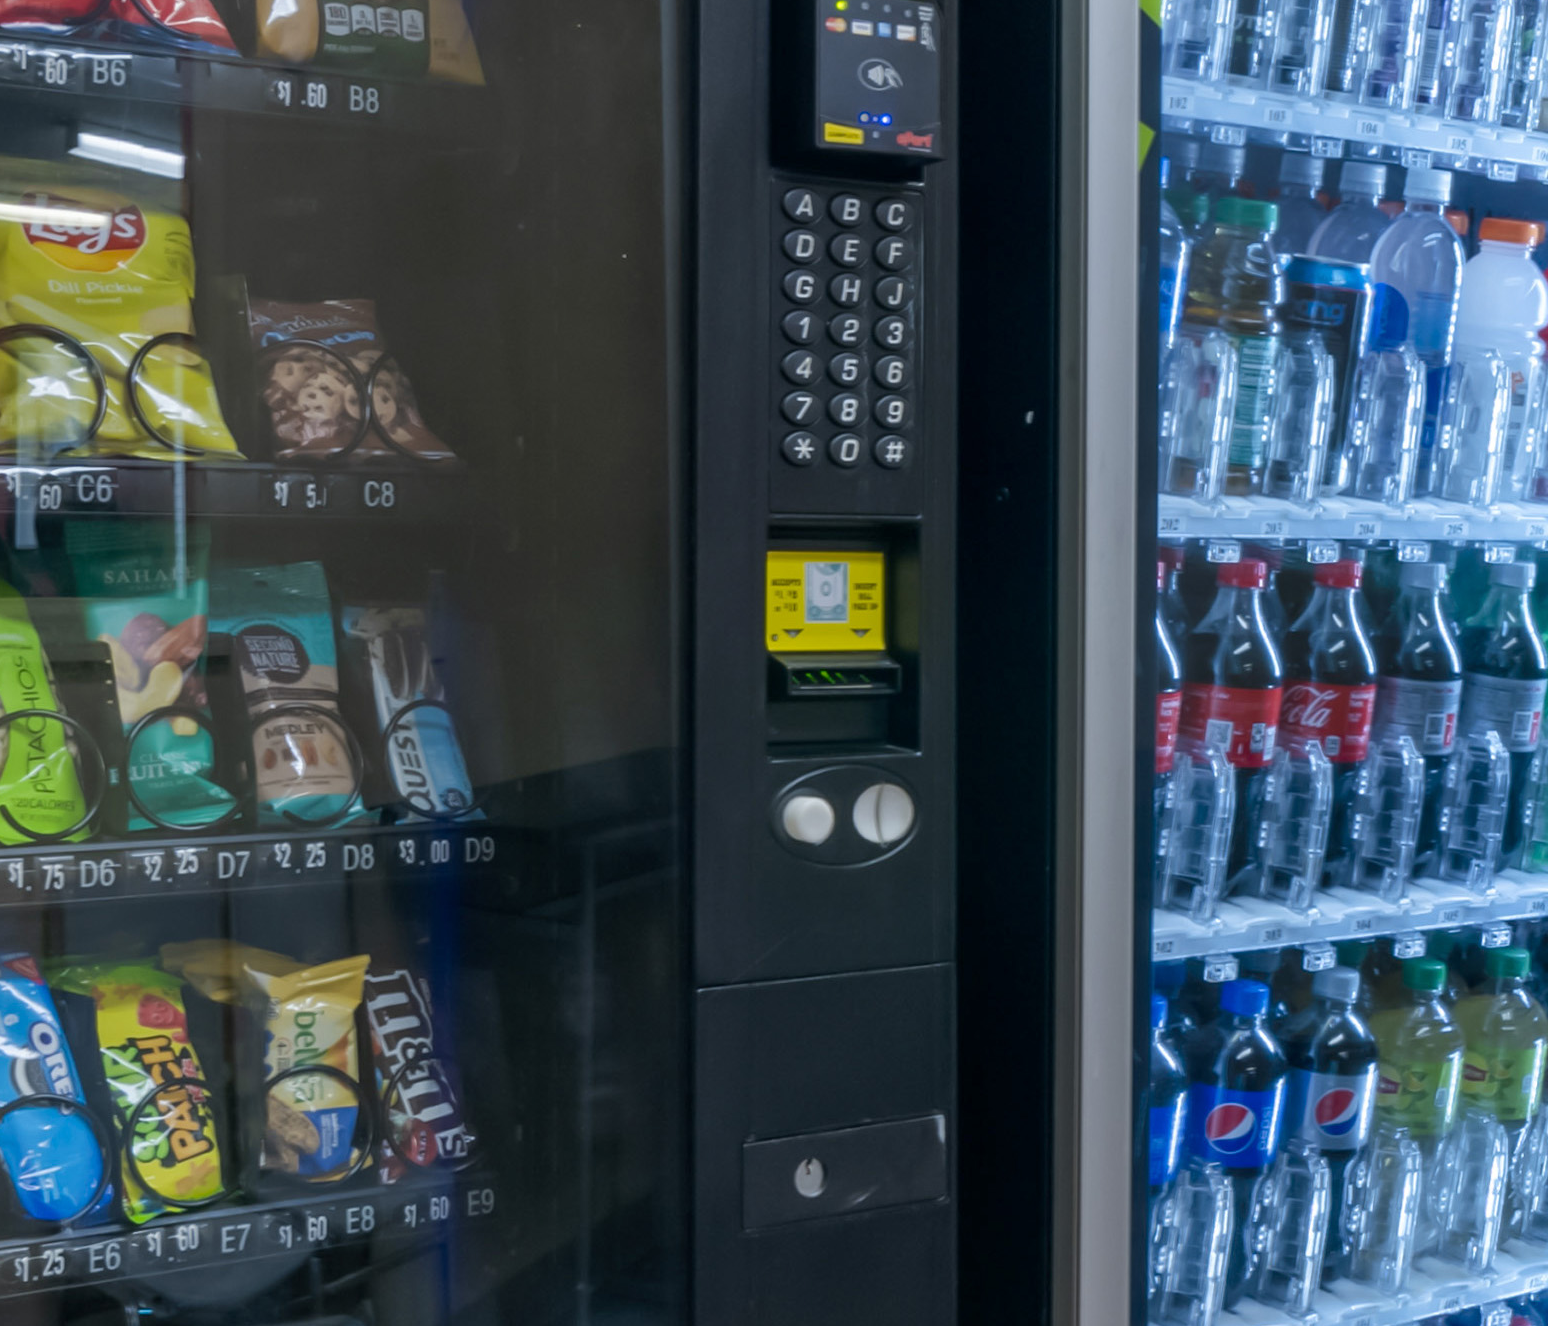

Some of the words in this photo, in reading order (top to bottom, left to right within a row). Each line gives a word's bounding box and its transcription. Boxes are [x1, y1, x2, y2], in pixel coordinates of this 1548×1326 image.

[93, 57, 127, 86] B6
[350, 84, 380, 114] B8
[795, 194, 814, 217] A
[843, 198, 860, 221] B
[887, 204, 905, 226] C
[796, 234, 815, 258] D
[843, 239, 860, 261] E
[888, 243, 903, 264] F
[796, 276, 815, 299] G
[841, 279, 861, 302] H
[888, 283, 903, 305] J
[799, 316, 810, 339] 1
[842, 319, 859, 341] 2
[887, 323, 903, 345] 3
[796, 357, 812, 379] 4
[842, 359, 859, 381] 5
[887, 362, 903, 384] 6
[796, 397, 813, 420] 7
[840, 399, 859, 422] 8
[887, 401, 904, 424] 9
[885, 441, 904, 463] #
[76, 474, 112, 503] C6
[363, 480, 396, 507] C8
[14, 655, 56, 795] PISTACHIOS
[265, 723, 327, 739] MEDLEY
[392, 718, 435, 814] QUEST
[343, 843, 375, 871] D8
[465, 837, 496, 863] D9
[80, 859, 117, 888] D6
[217, 851, 251, 879] D7
[134, 1034, 214, 1163] PATCH
[467, 1188, 495, 1216] E9
[346, 1205, 376, 1234] E8
[221, 1223, 251, 1253] E7
[89, 1242, 122, 1273] E6
